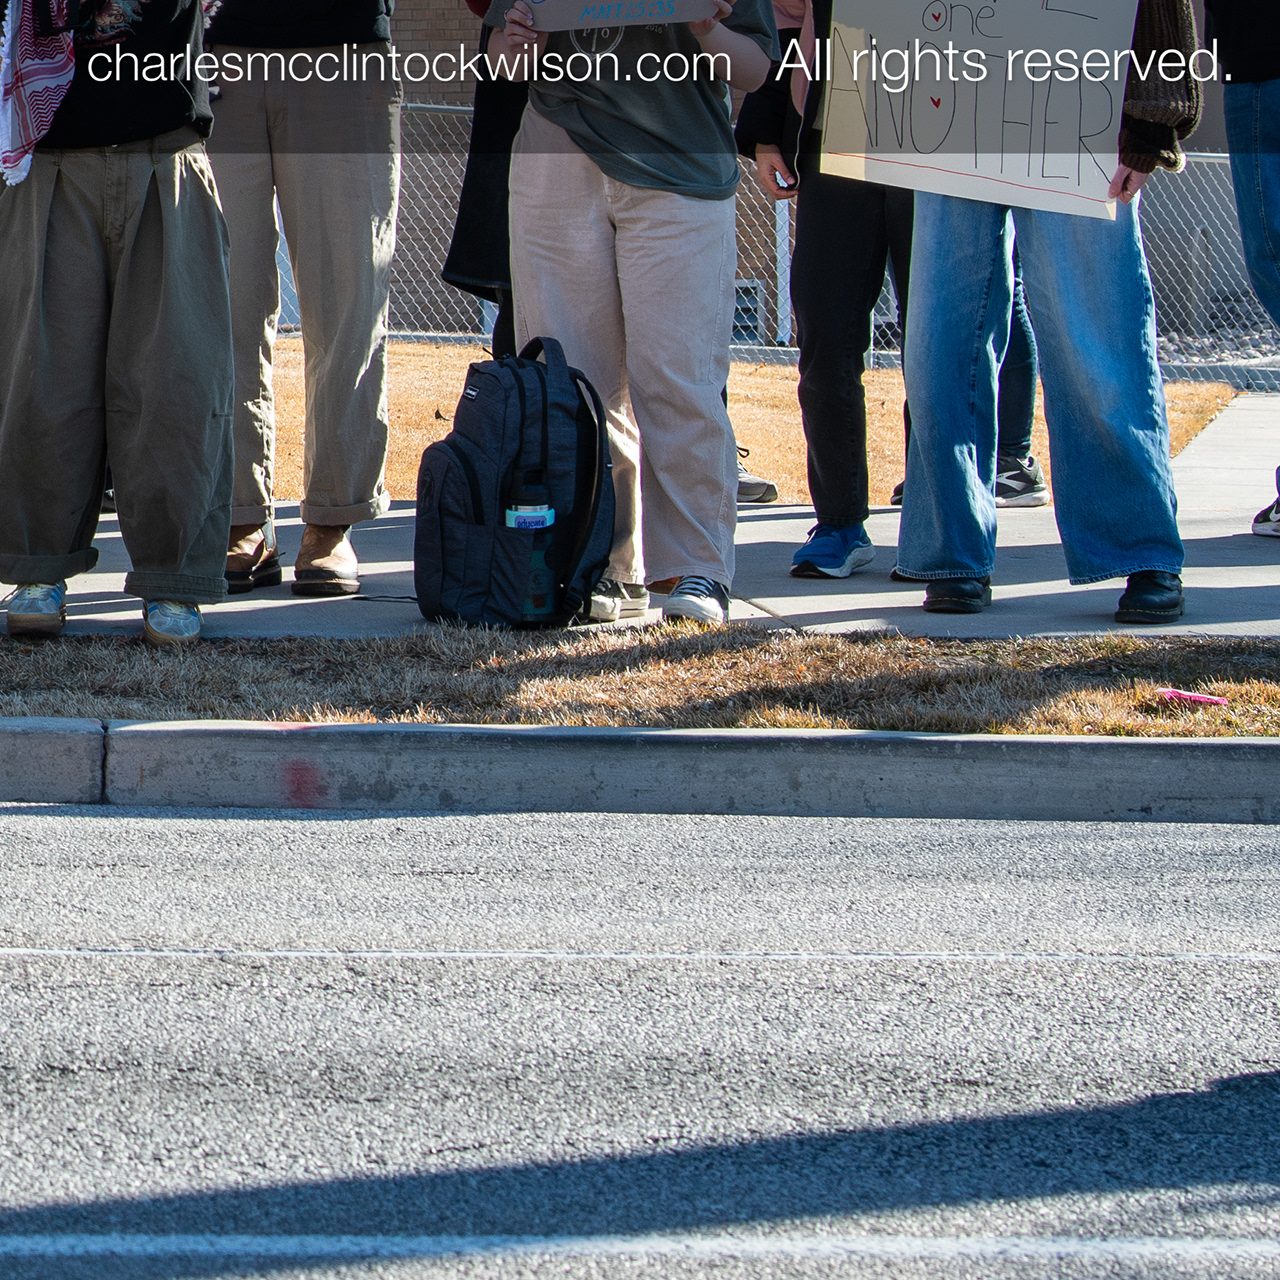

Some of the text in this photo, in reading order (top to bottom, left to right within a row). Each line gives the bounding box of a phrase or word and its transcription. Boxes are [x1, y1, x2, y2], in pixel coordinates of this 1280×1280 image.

[579, 0, 675, 21] MATT 25:35
[921, 0, 1004, 39] one
[823, 26, 1112, 187] ANOTHER
